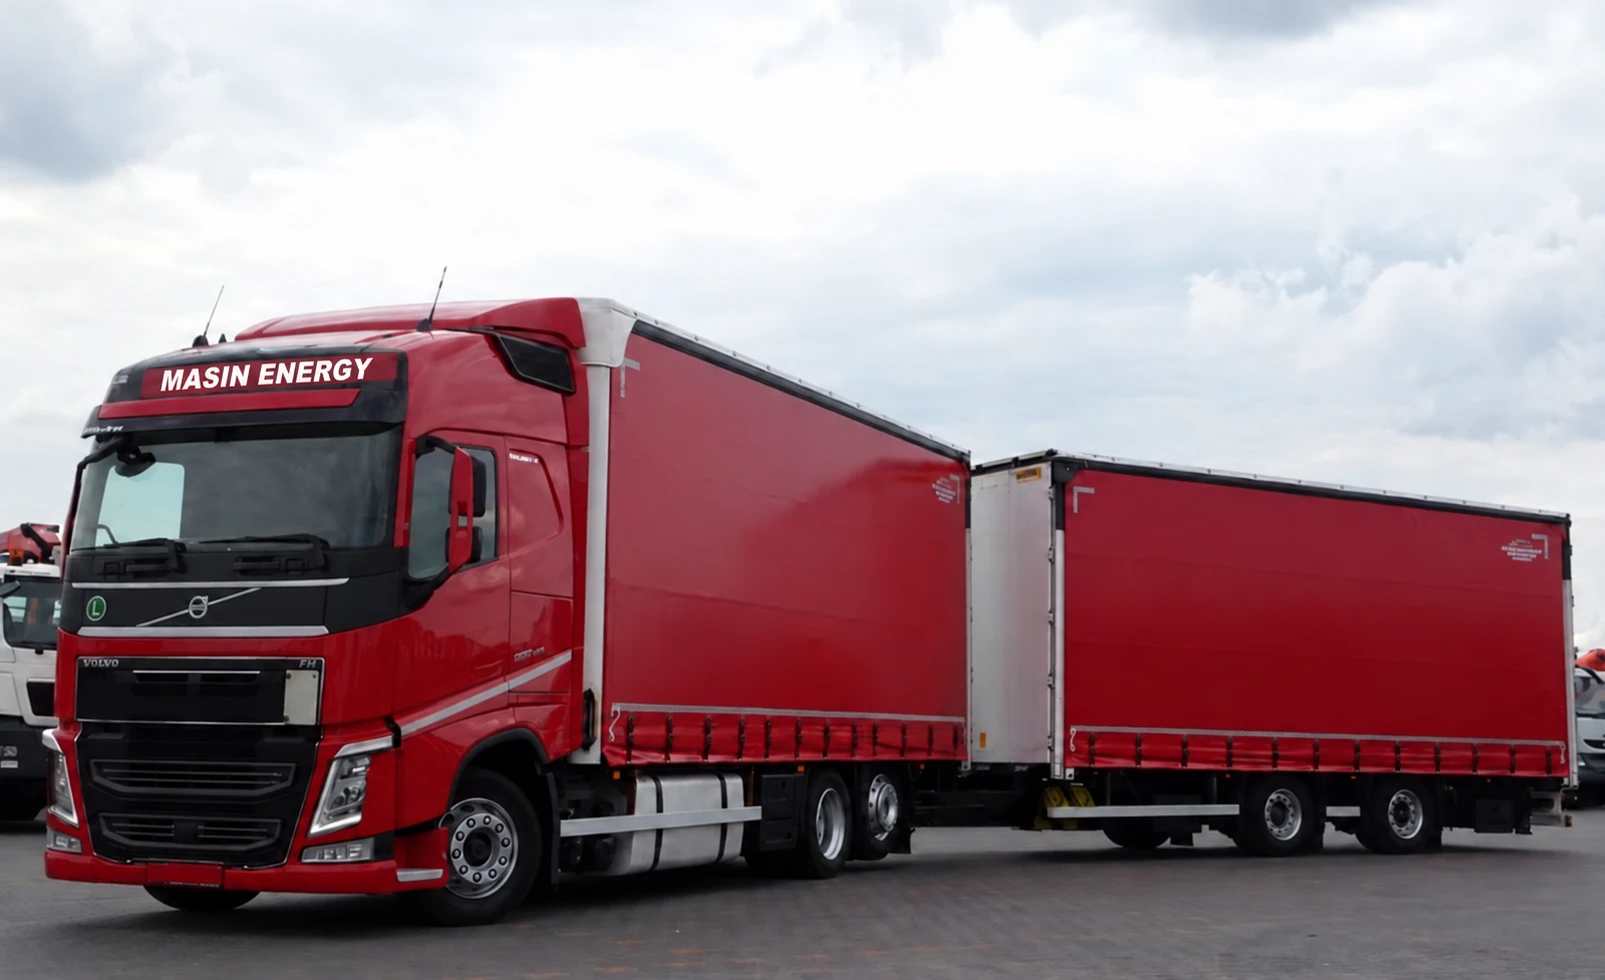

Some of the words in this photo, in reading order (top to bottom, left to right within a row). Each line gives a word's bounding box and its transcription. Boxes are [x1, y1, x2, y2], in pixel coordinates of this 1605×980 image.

[160, 364, 251, 392] MASIN
[257, 357, 373, 386] ENERGY
[92, 600, 101, 616] L
[83, 659, 119, 667] VOLVO
[299, 659, 316, 668] FH
